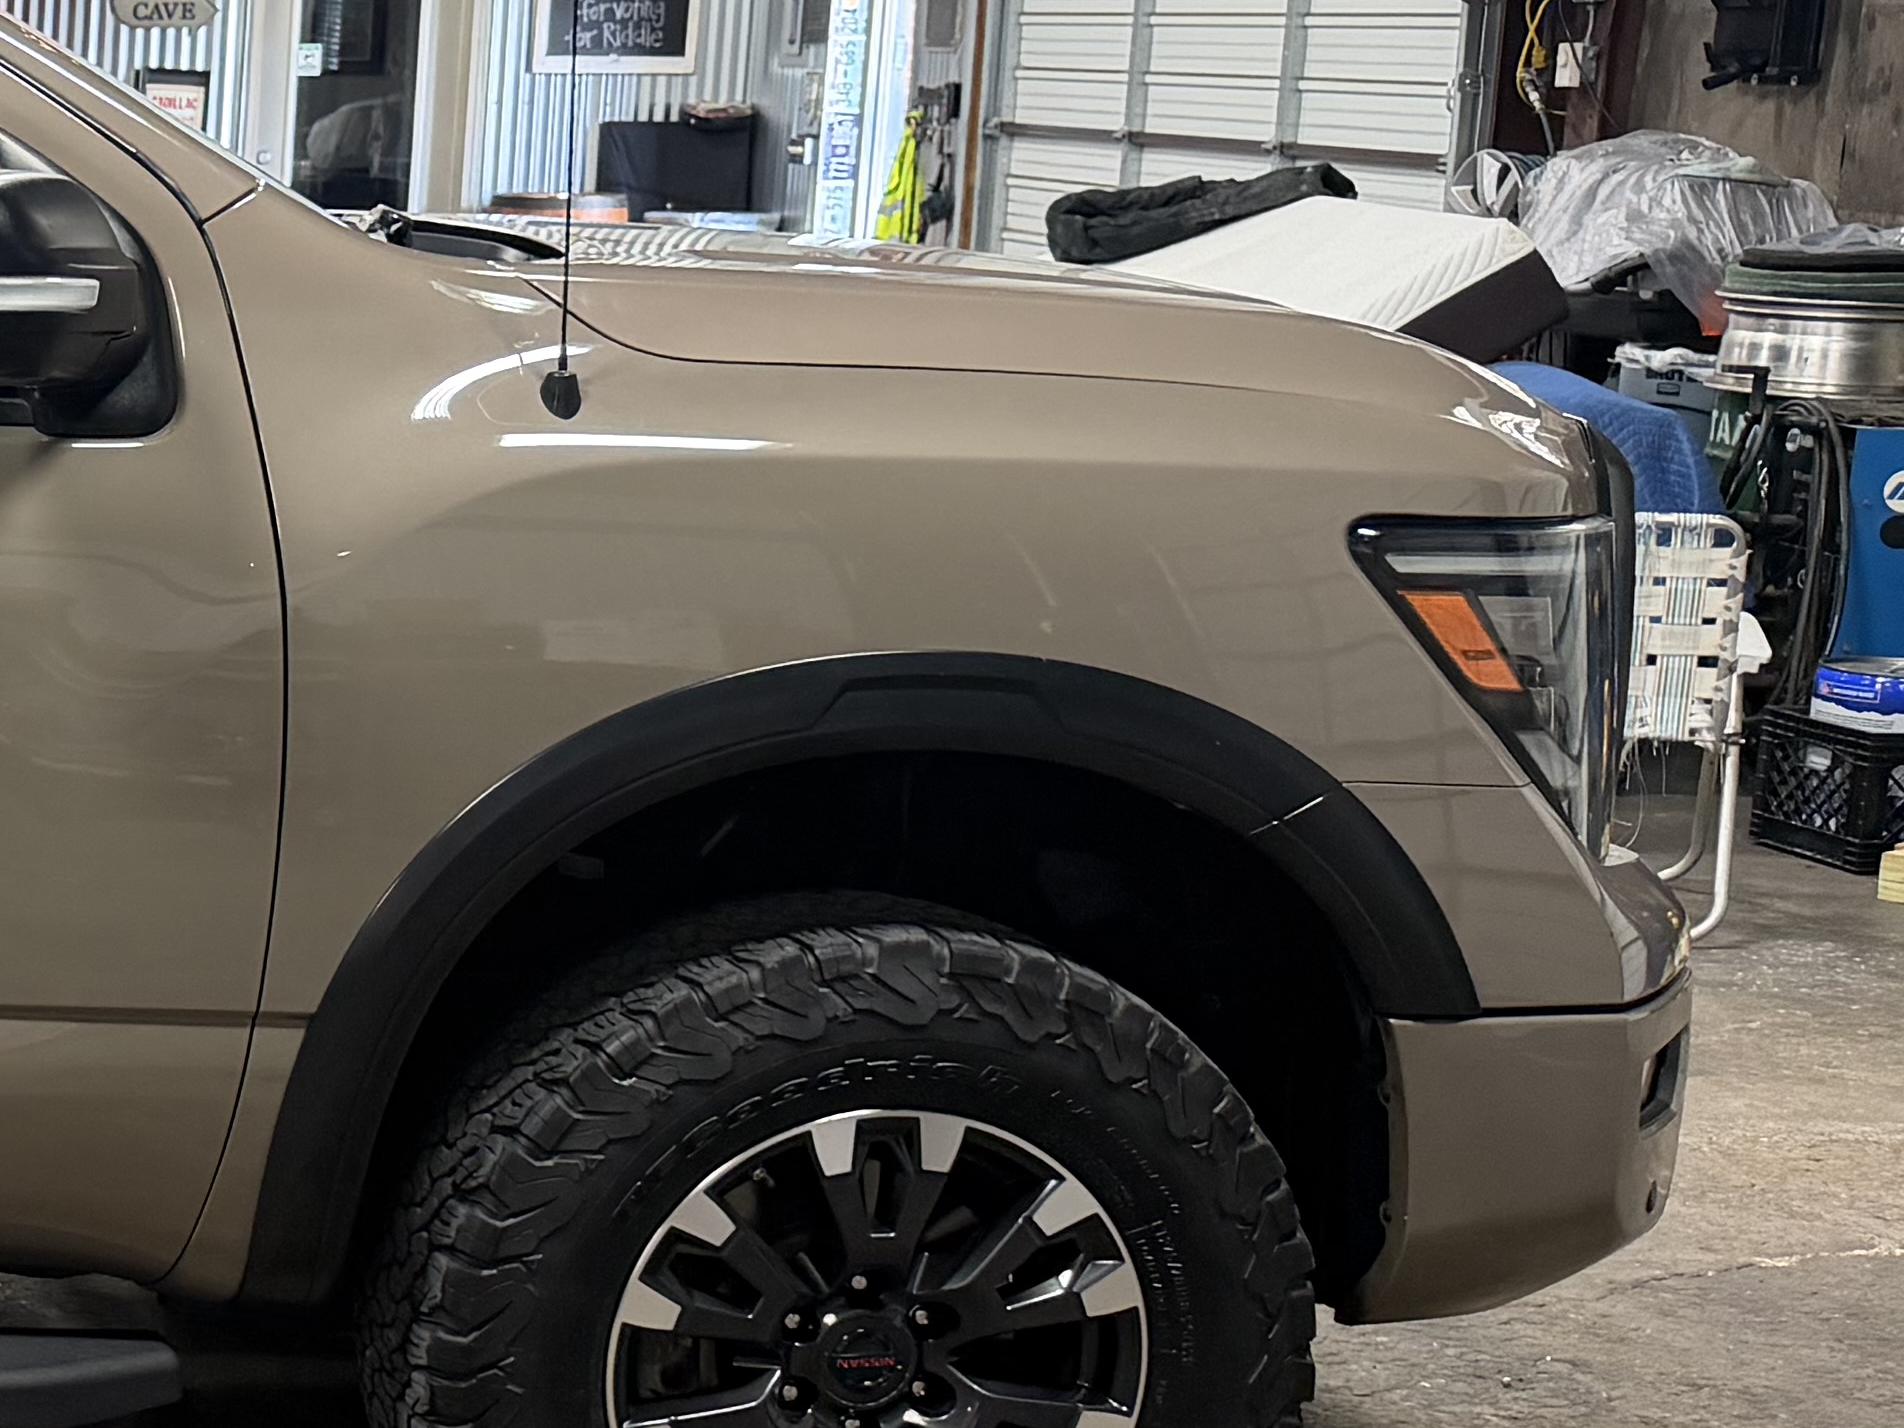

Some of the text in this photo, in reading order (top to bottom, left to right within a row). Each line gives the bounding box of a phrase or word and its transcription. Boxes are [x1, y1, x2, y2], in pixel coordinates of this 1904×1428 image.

[132, 2, 196, 21] CAVE
[603, 22, 664, 49] Riddle
[835, 1357, 897, 1370] NISSAN
